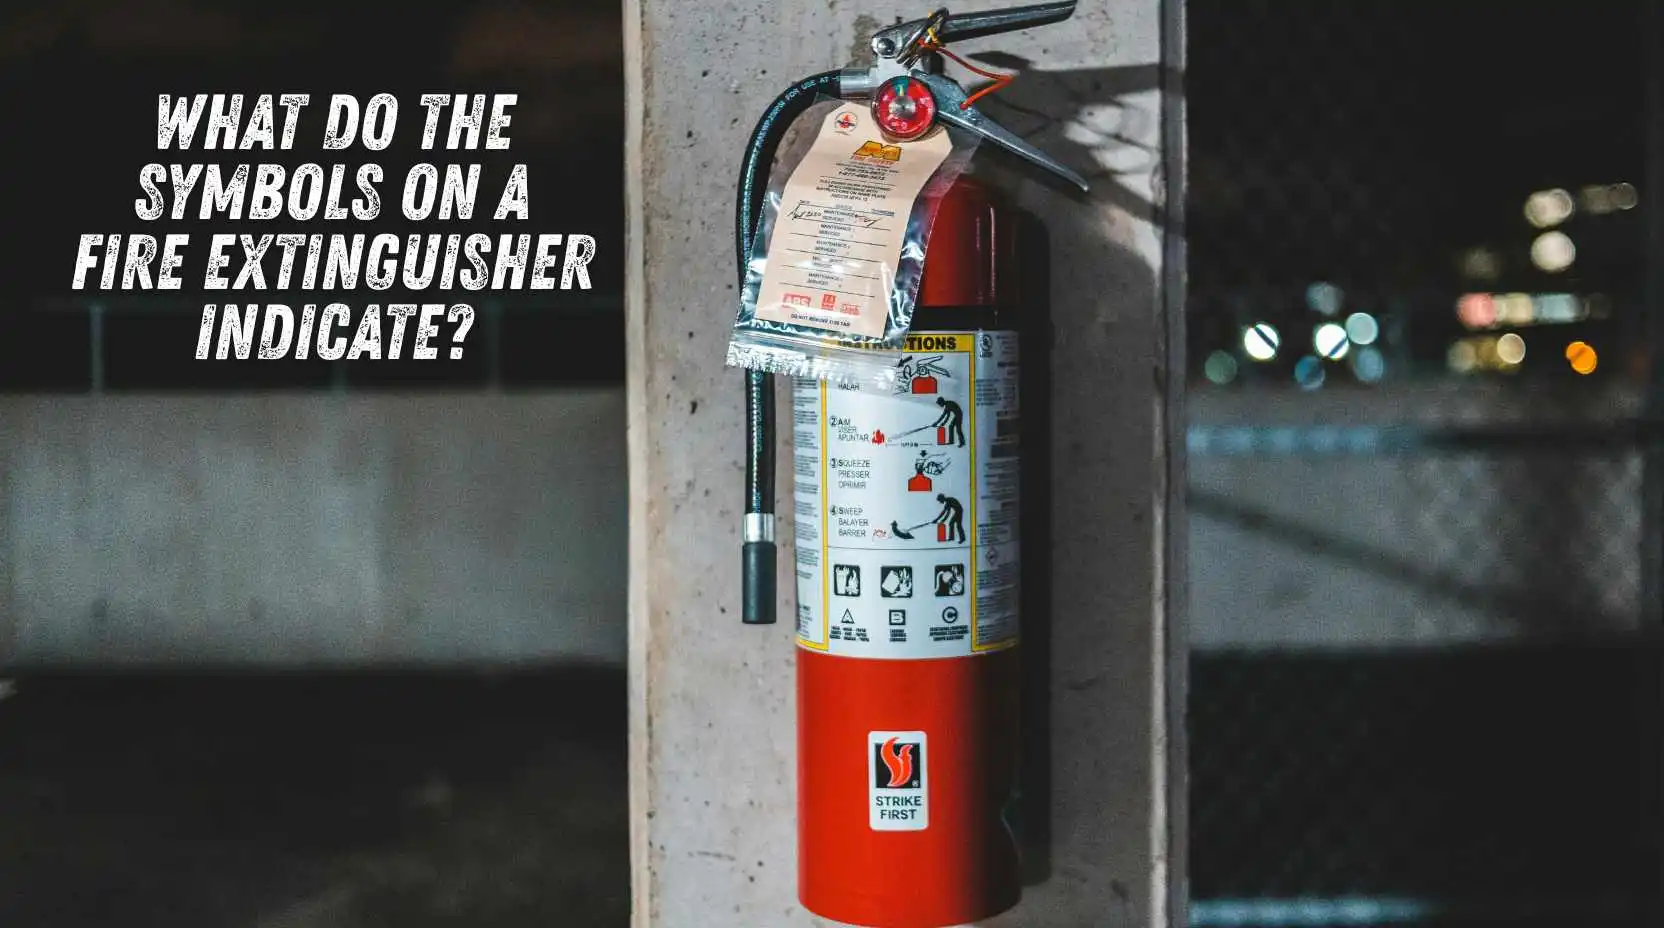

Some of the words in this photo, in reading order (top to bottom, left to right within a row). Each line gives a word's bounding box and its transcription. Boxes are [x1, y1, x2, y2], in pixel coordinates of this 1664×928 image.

[838, 433, 869, 442] APUNTAR
[838, 459, 871, 468] SQUEEZE
[838, 470, 870, 479] PRESSER
[838, 507, 863, 515] SWEEP
[838, 518, 869, 527] BALAYER
[838, 529, 866, 537] BARRER
[890, 610, 904, 624] B
[875, 795, 922, 807] STRIKE
[880, 809, 917, 820] FIRST
